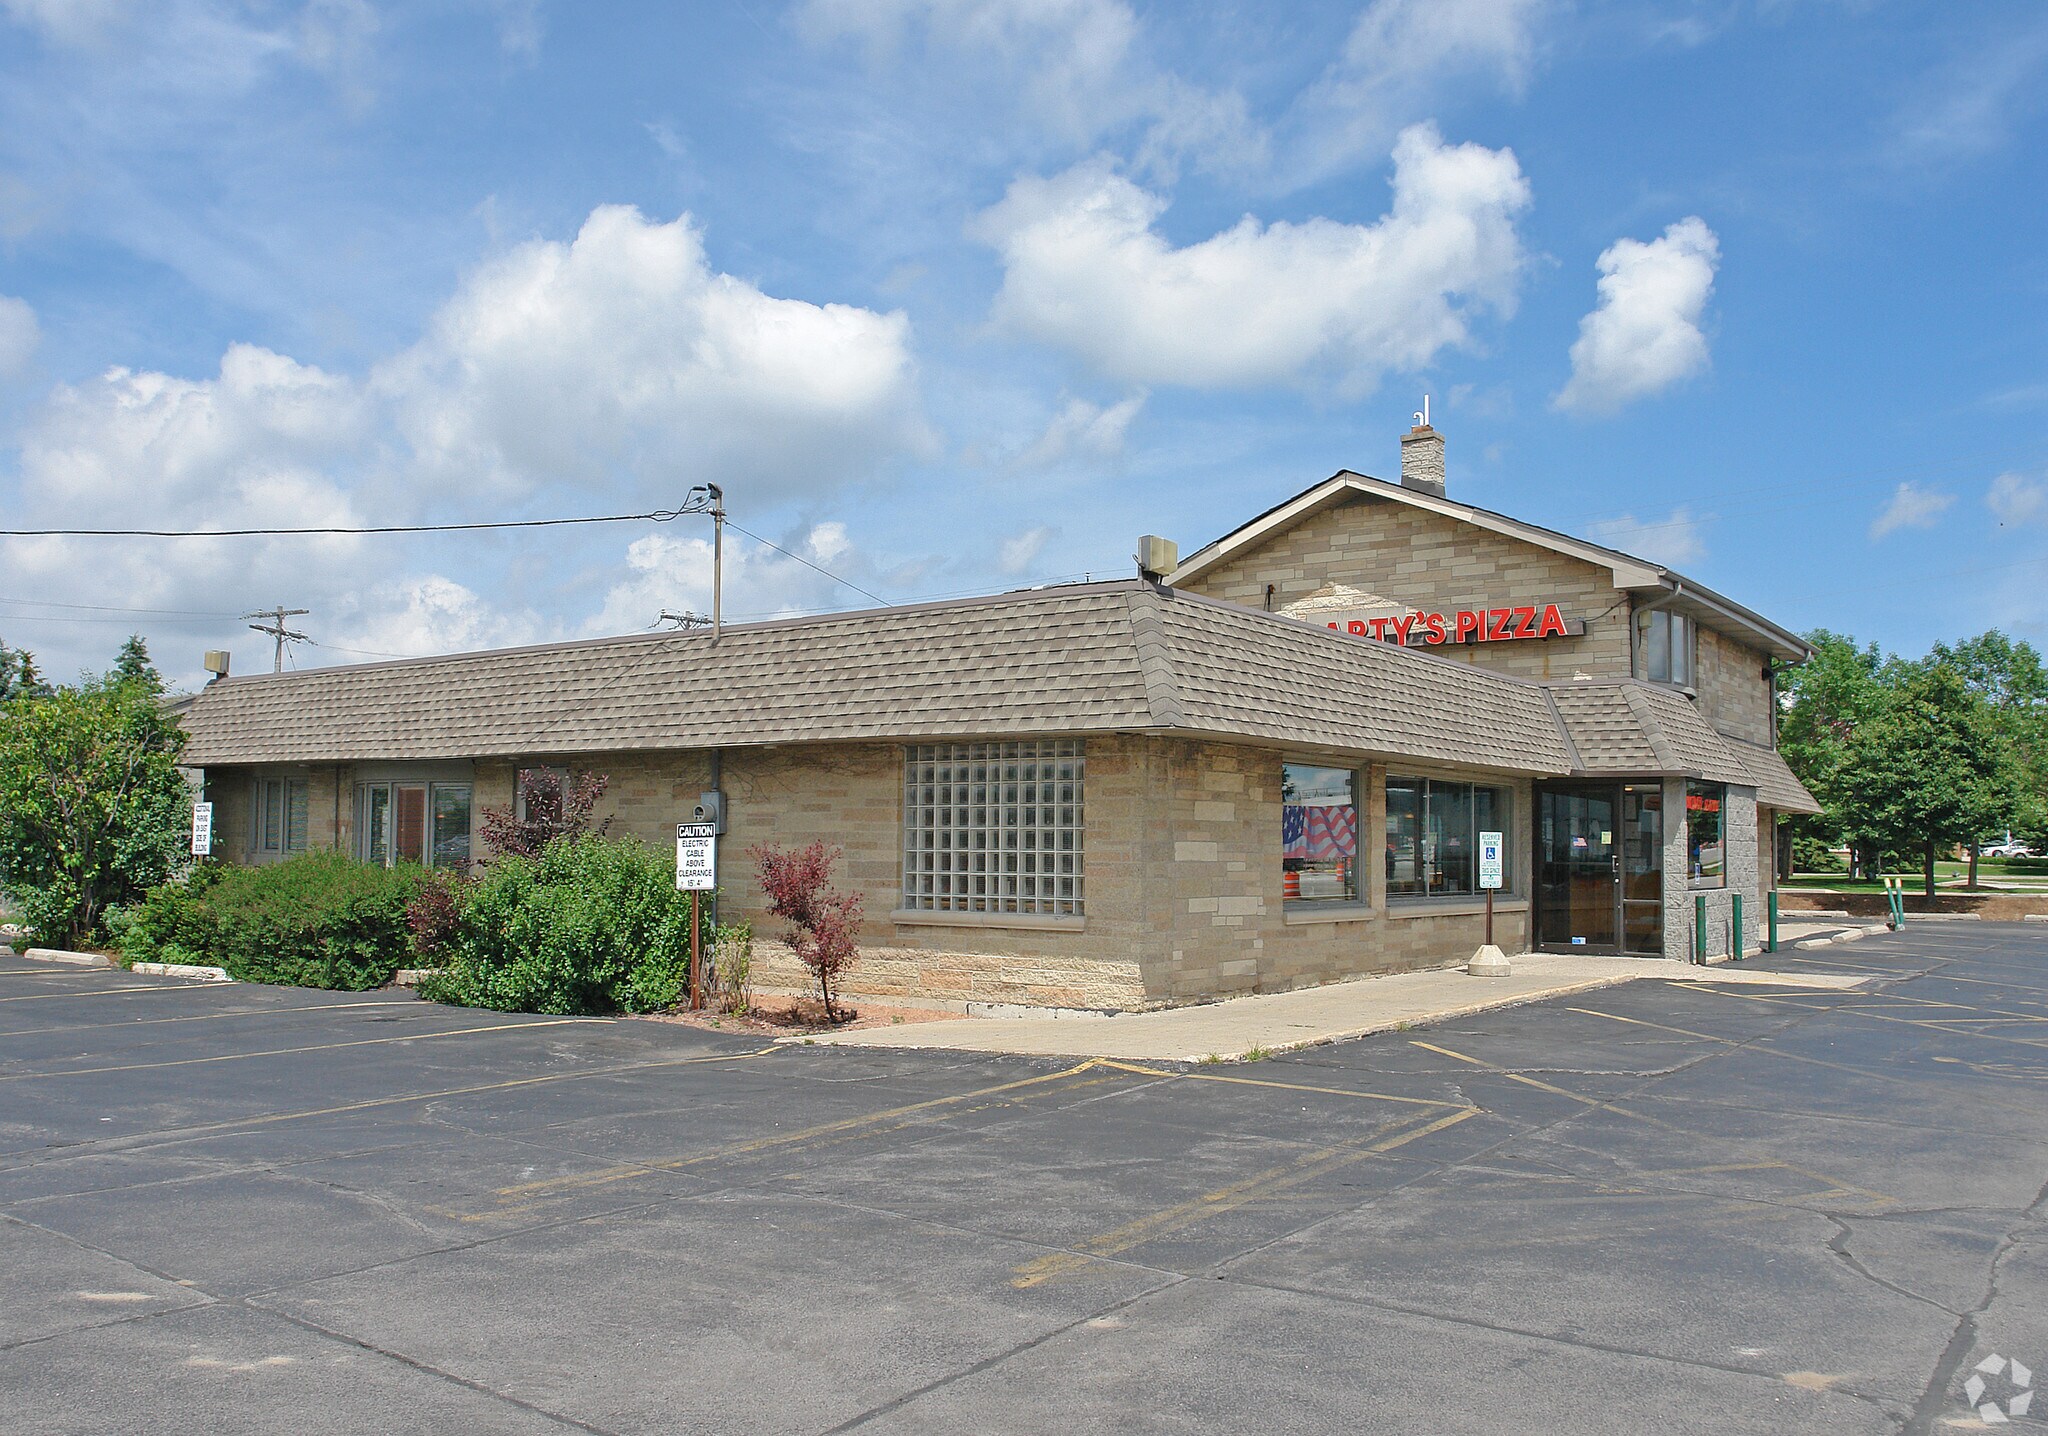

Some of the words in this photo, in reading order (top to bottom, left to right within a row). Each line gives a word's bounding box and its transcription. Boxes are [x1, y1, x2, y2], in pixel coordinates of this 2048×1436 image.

[1456, 604, 1568, 644] PIZZA
[679, 825, 713, 837] CAUTION
[681, 839, 710, 848] ELECTRIC
[685, 849, 705, 858] CABLE
[685, 859, 705, 867] ABOVE
[678, 868, 713, 878] CLEARANCE
